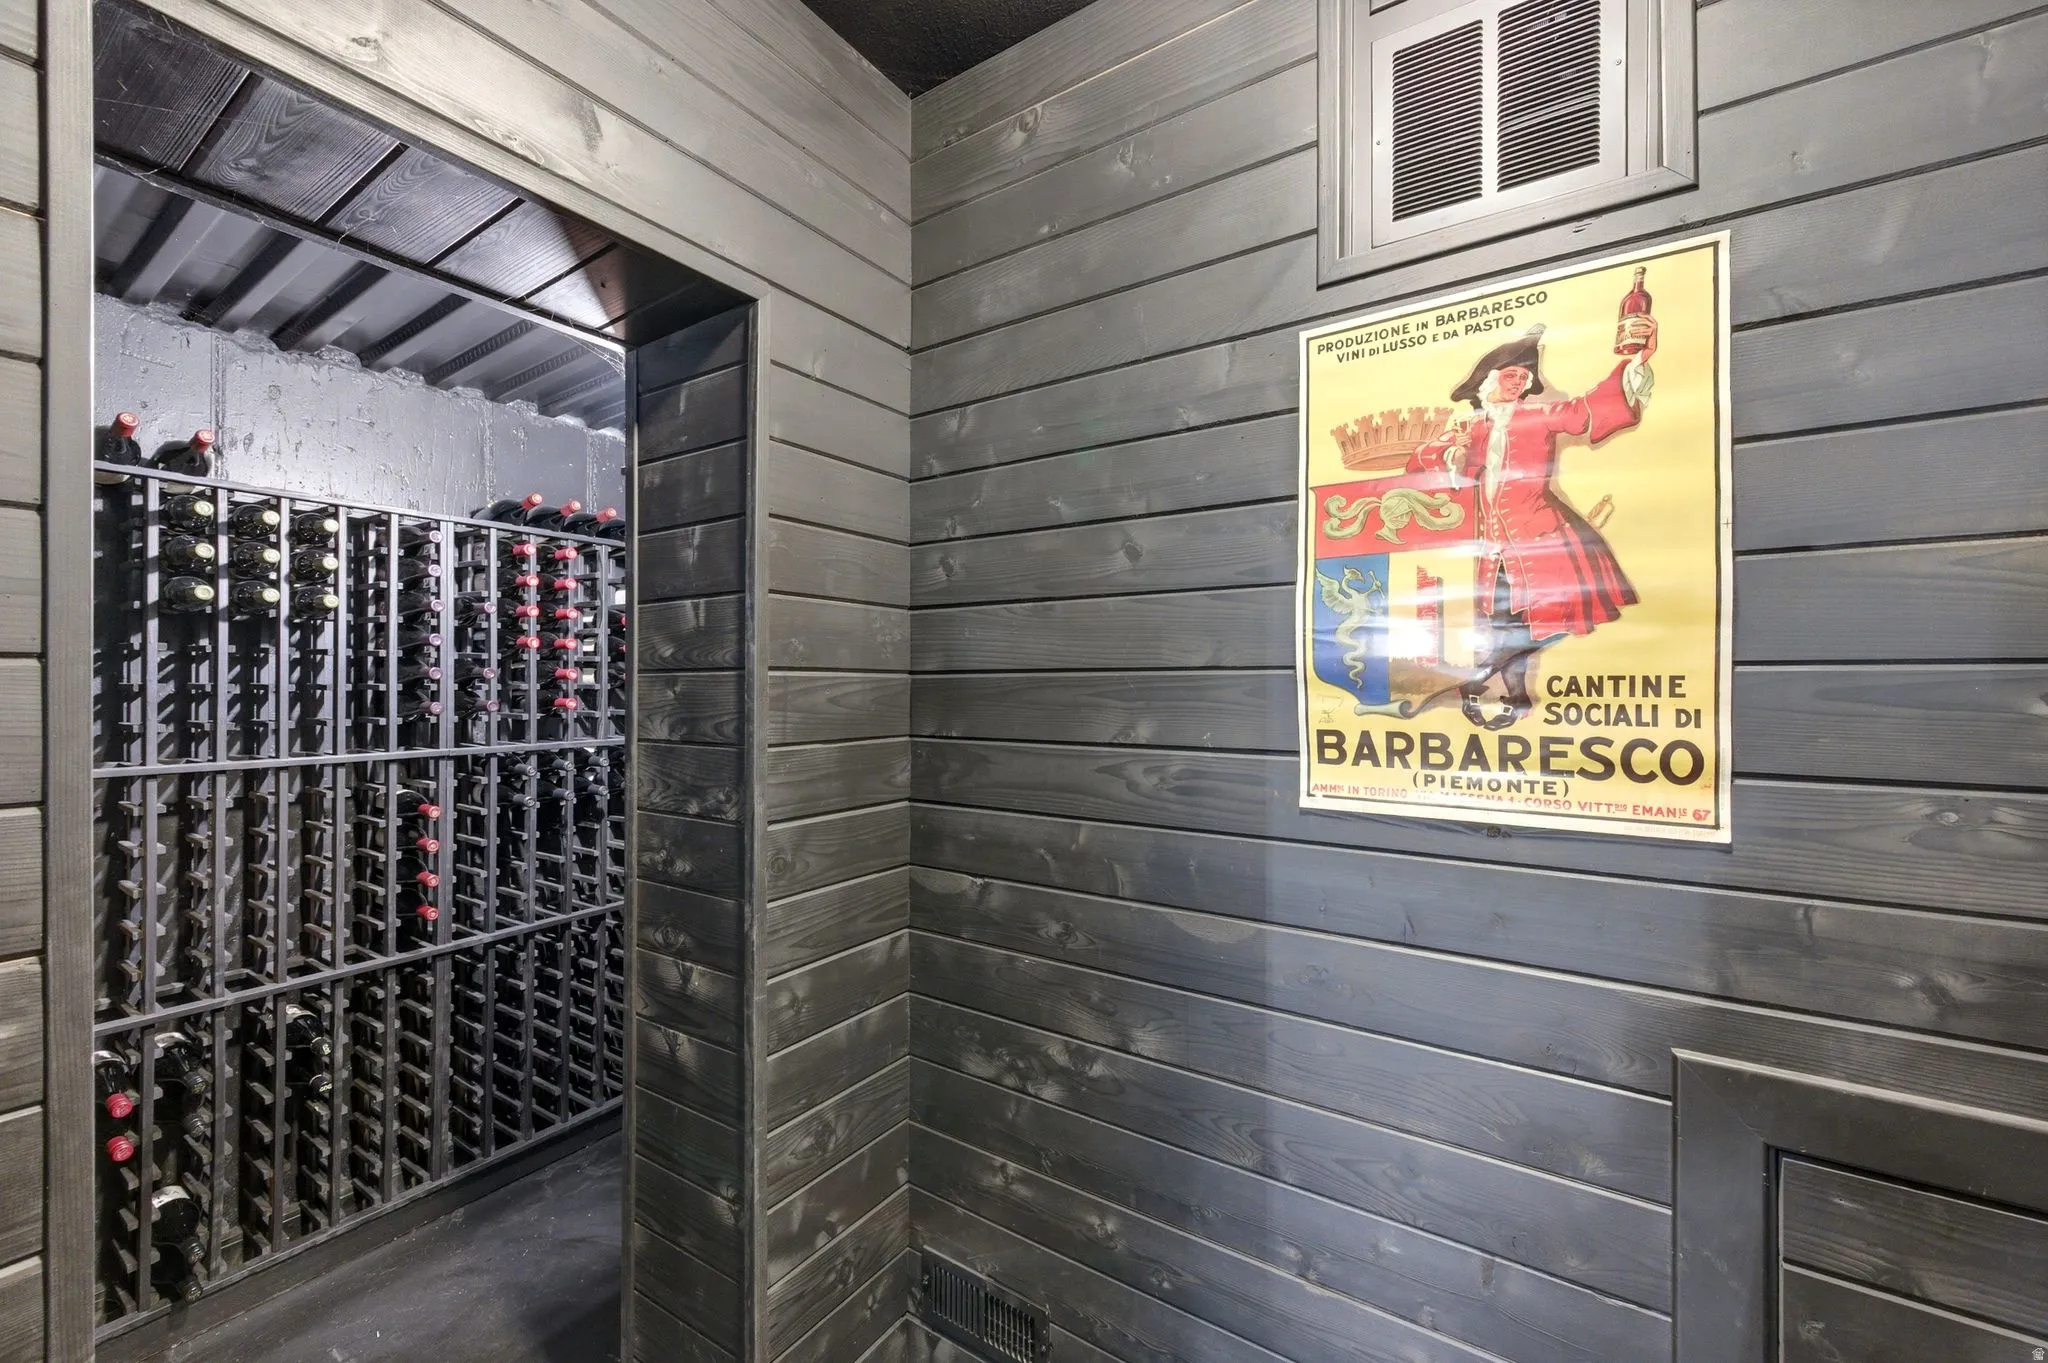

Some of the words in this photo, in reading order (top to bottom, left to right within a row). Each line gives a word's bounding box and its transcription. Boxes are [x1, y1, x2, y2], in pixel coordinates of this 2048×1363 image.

[1317, 323, 1411, 355] PRODUZIONE
[1416, 320, 1429, 332] IN
[1435, 290, 1548, 327] BARBARESCO
[1336, 348, 1365, 363] VINI
[1382, 334, 1427, 354] LUSSO
[1432, 333, 1439, 343] E
[1443, 329, 1460, 340] DA
[1464, 314, 1515, 336] PASTO
[1546, 674, 1686, 698] CANTINE
[1543, 702, 1659, 727] SOCIALI
[1675, 708, 1702, 729] DI
[1316, 729, 1705, 786] BARBARESCO
[1412, 771, 1569, 798] (PIEMONTE)
[1348, 785, 1360, 795] IN
[1363, 786, 1408, 799] TORINO
[1524, 798, 1572, 811] CORSO
[1692, 809, 1711, 821] 67
